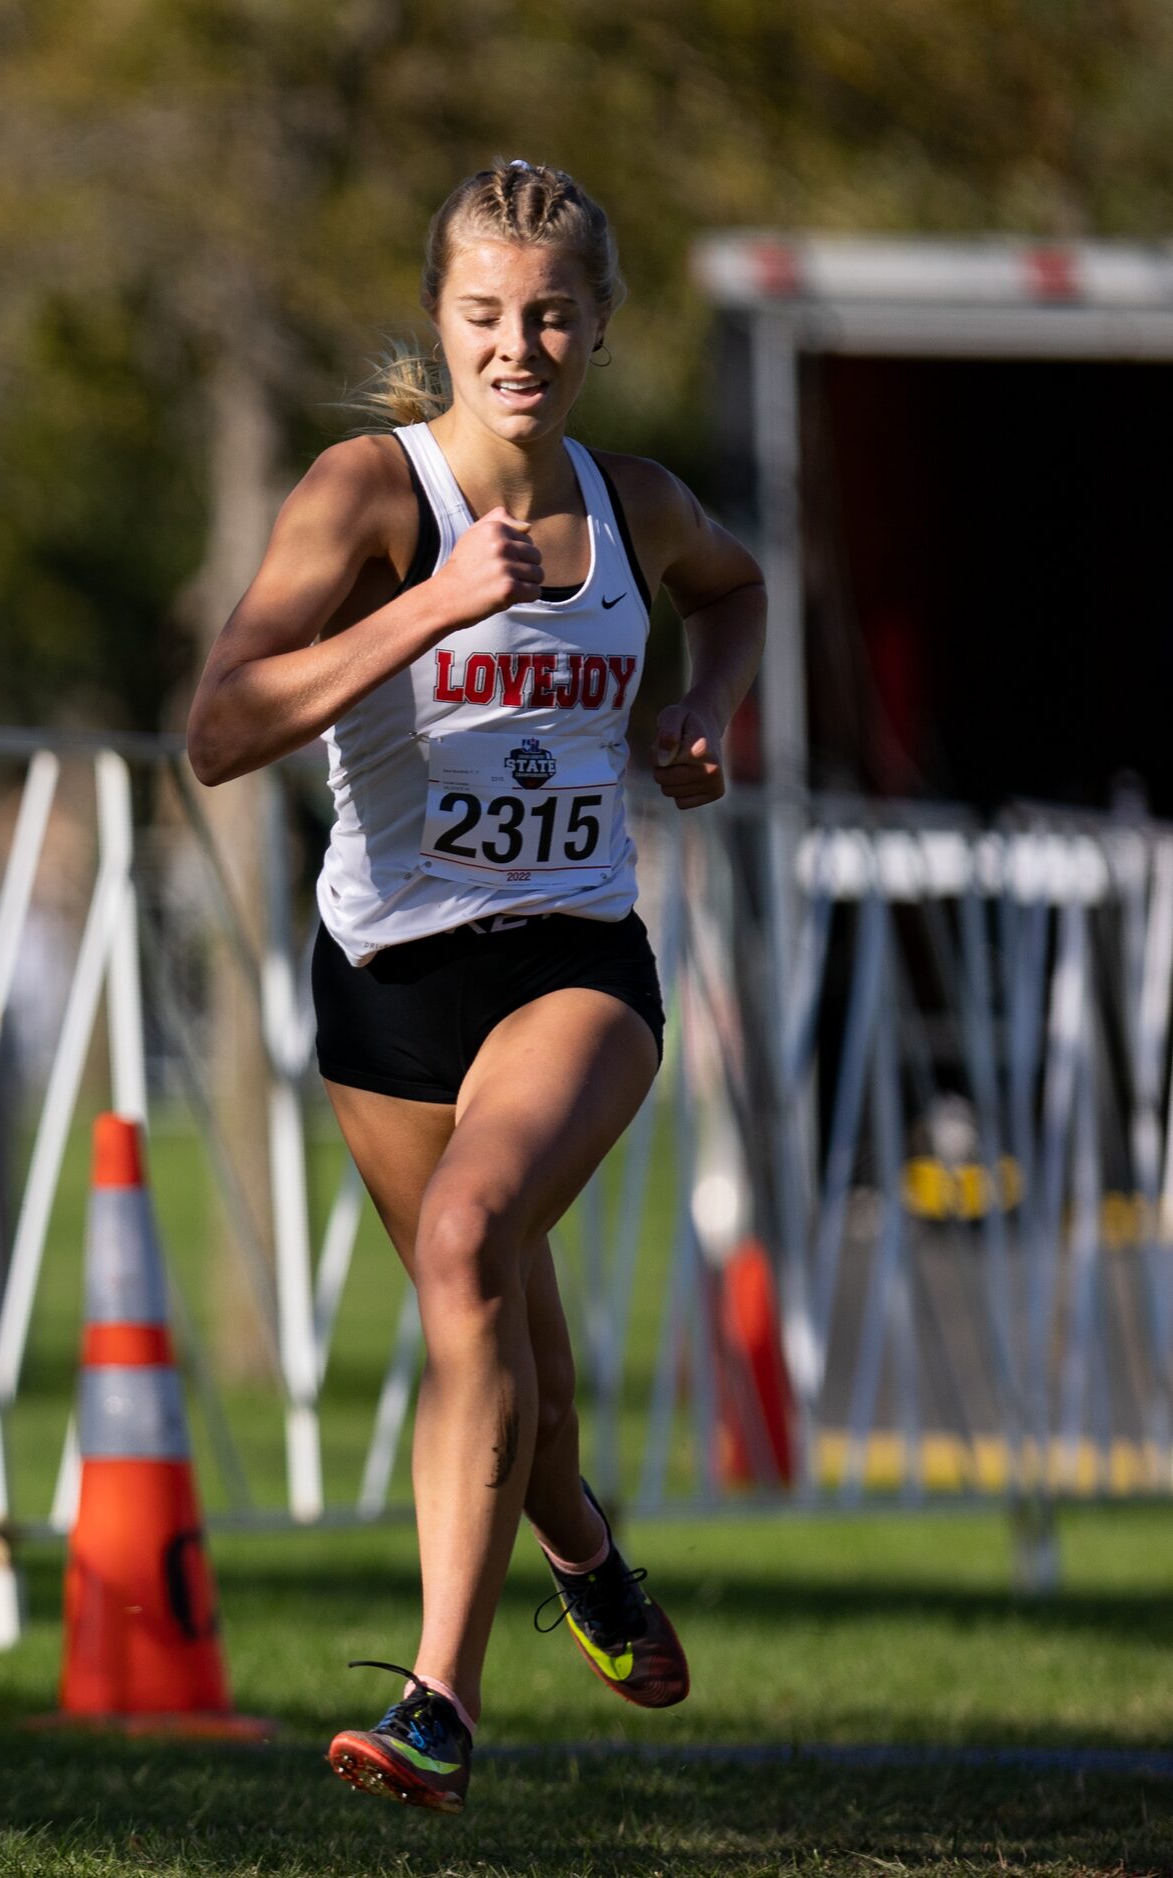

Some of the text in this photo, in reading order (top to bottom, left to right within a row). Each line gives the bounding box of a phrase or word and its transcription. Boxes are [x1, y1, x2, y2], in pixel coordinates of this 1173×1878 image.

[434, 648, 637, 710] LOVEJOY
[505, 758, 556, 773] STATE
[433, 792, 603, 864] 2315
[506, 872, 532, 881] 2022
